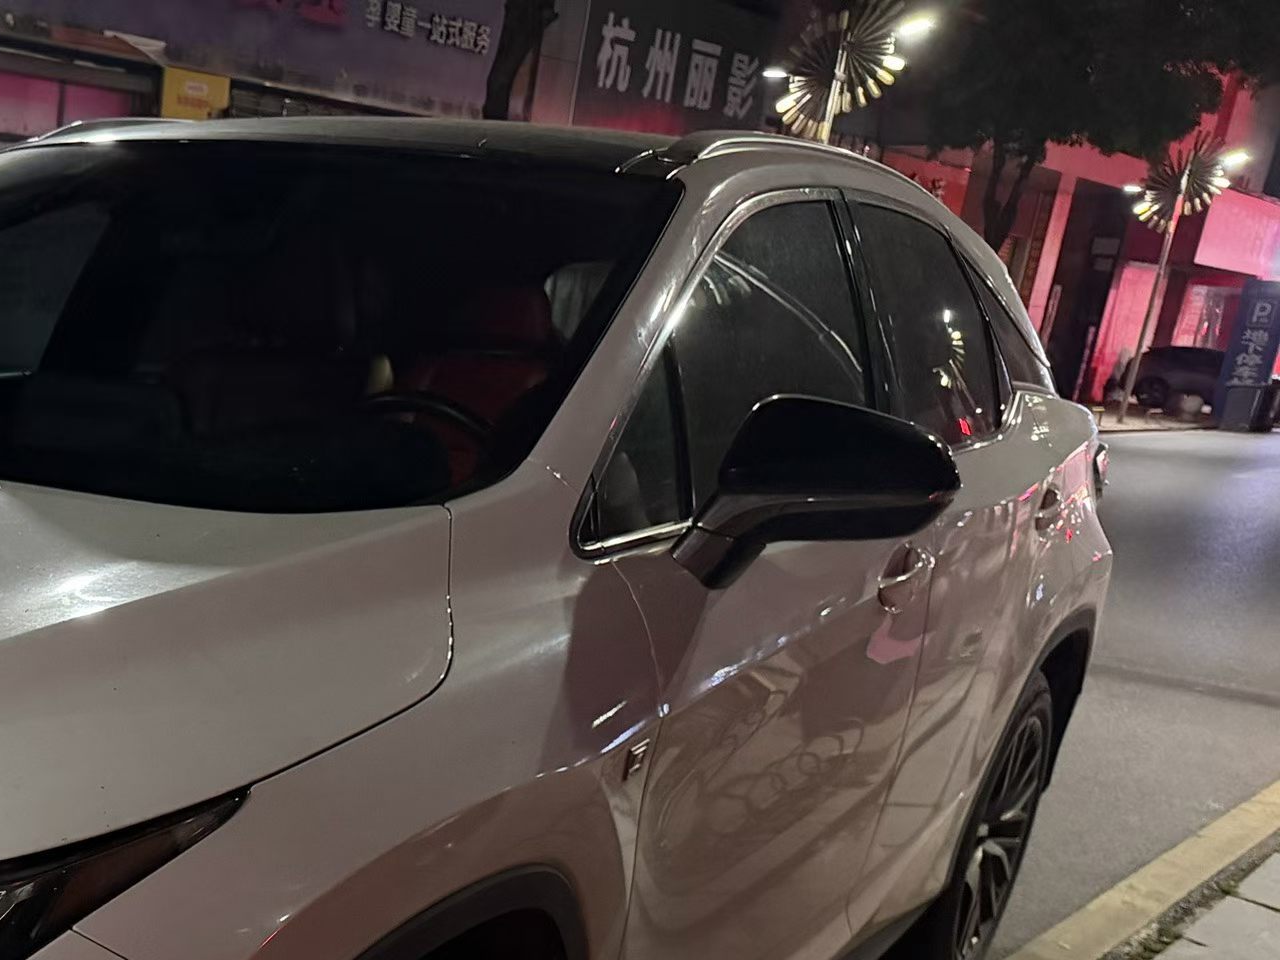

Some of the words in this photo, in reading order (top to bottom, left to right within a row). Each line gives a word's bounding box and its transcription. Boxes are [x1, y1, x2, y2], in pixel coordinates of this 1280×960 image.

[596, 11, 760, 119] 杭州丽影
[1252, 301, 1272, 322] P
